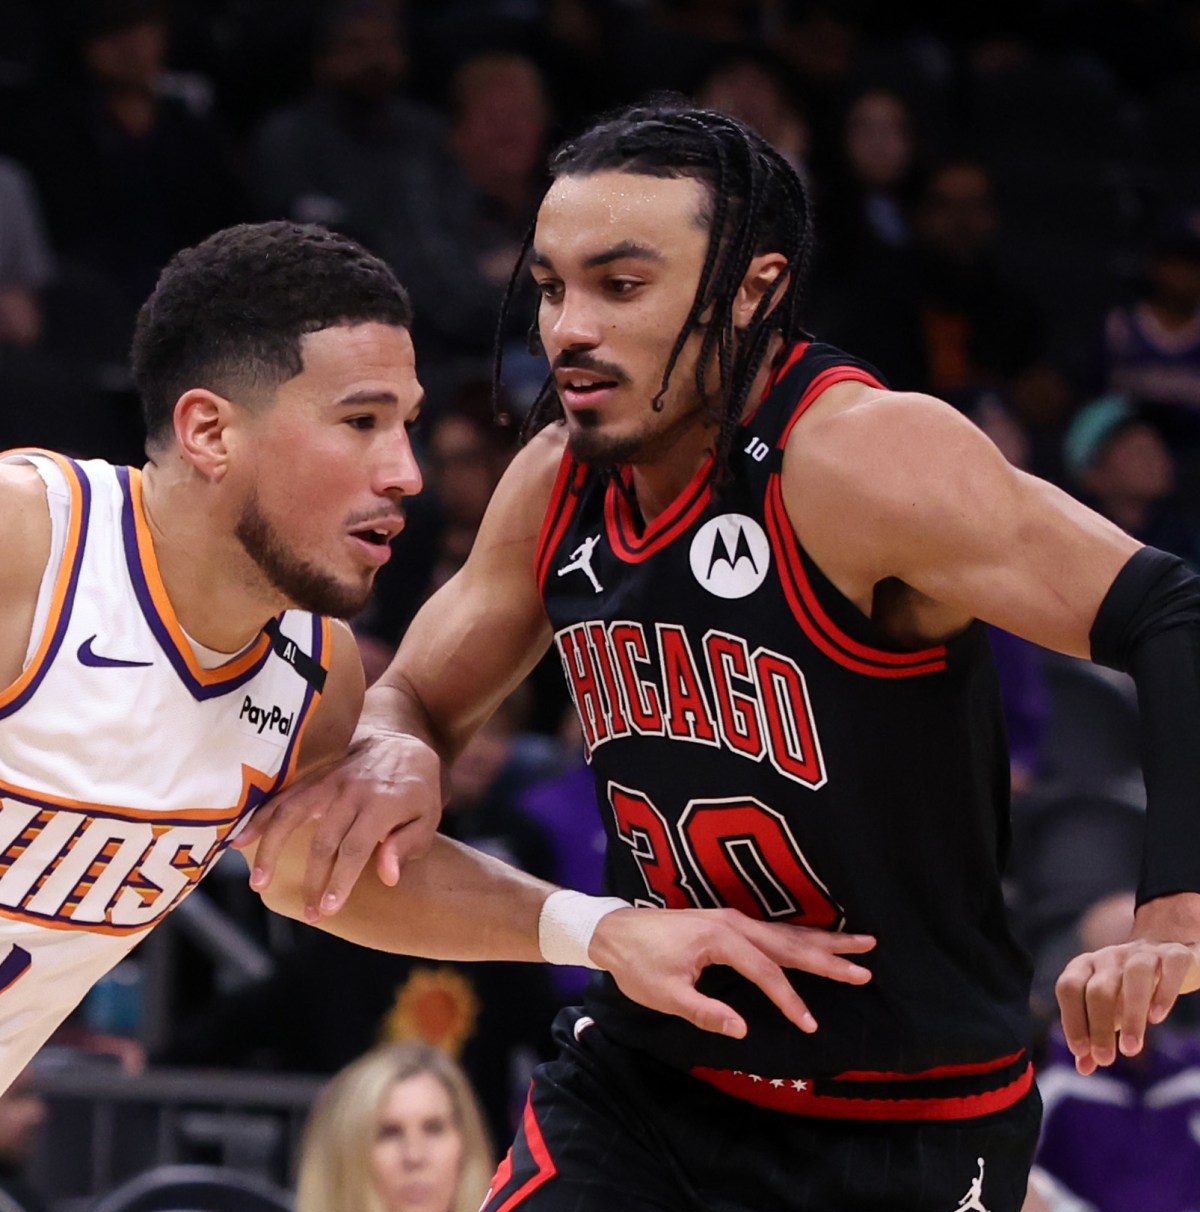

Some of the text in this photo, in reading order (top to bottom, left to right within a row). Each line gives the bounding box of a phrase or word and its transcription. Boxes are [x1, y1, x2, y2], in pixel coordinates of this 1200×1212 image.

[744, 437, 769, 461] 10
[283, 641, 297, 665] AL
[239, 695, 294, 736] PayPal
[555, 620, 828, 791] HICAGO
[607, 781, 845, 932] 30
